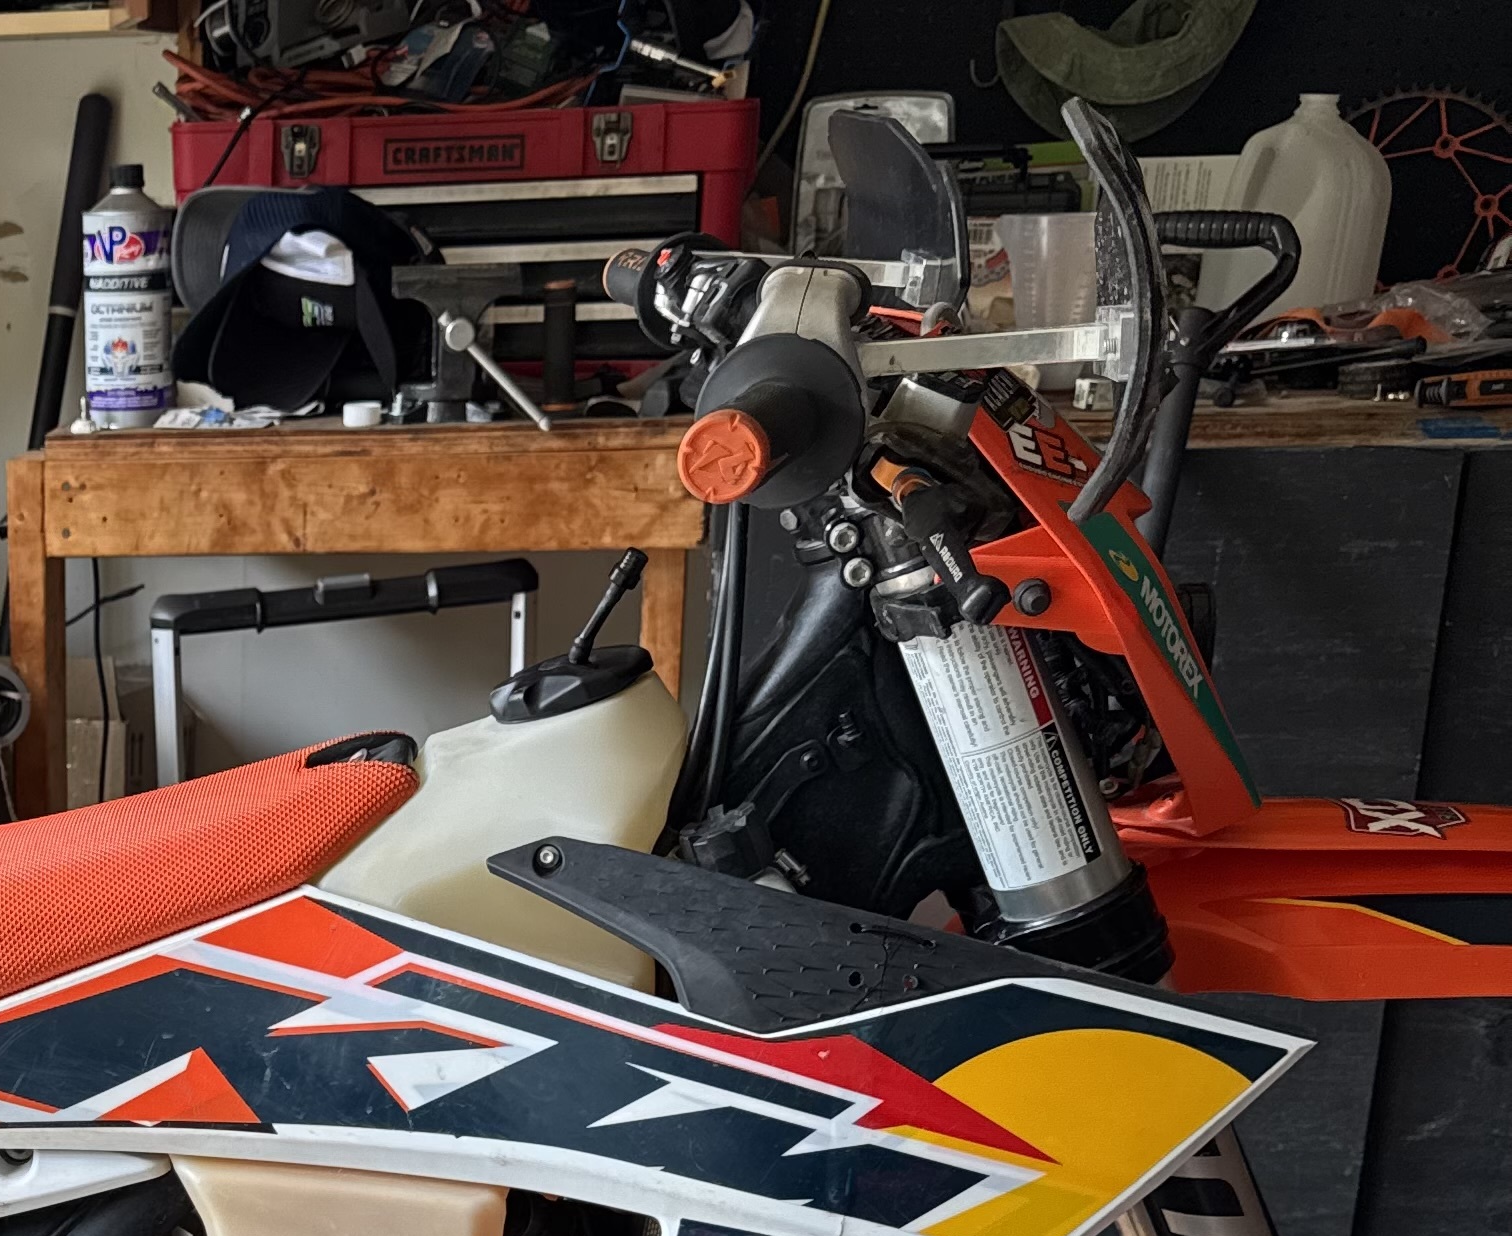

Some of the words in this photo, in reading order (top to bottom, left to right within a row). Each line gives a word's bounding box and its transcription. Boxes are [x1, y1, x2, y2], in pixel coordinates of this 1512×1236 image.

[392, 145, 517, 166] CRAFTSMAN
[1004, 626, 1041, 699] WARNING
[1141, 575, 1204, 698] MOTOREX
[1047, 748, 1086, 827] COMPETITION
[1075, 826, 1095, 855] ONLY
